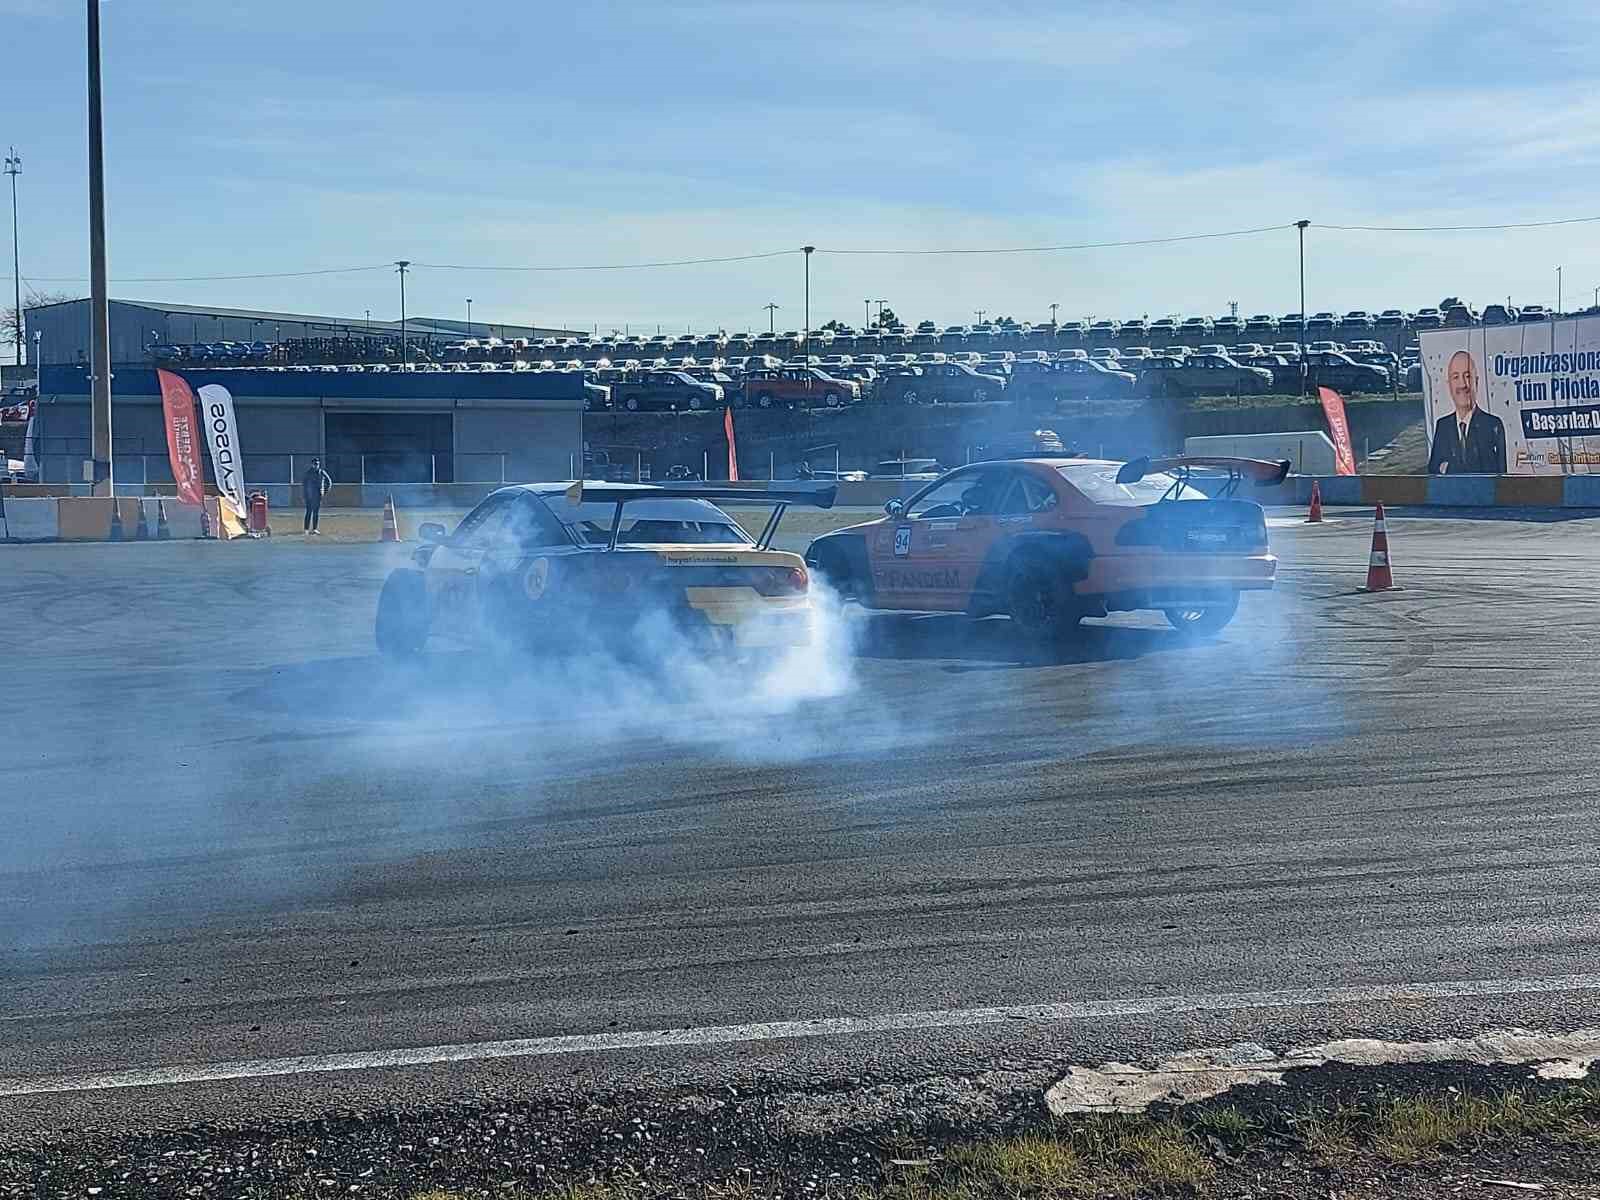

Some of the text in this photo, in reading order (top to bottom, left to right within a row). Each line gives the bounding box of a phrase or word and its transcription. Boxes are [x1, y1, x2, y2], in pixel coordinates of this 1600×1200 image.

[1514, 376, 1600, 401] Tüm Pilotla
[1532, 411, 1590, 433] Başarılar
[895, 534, 910, 550] 94
